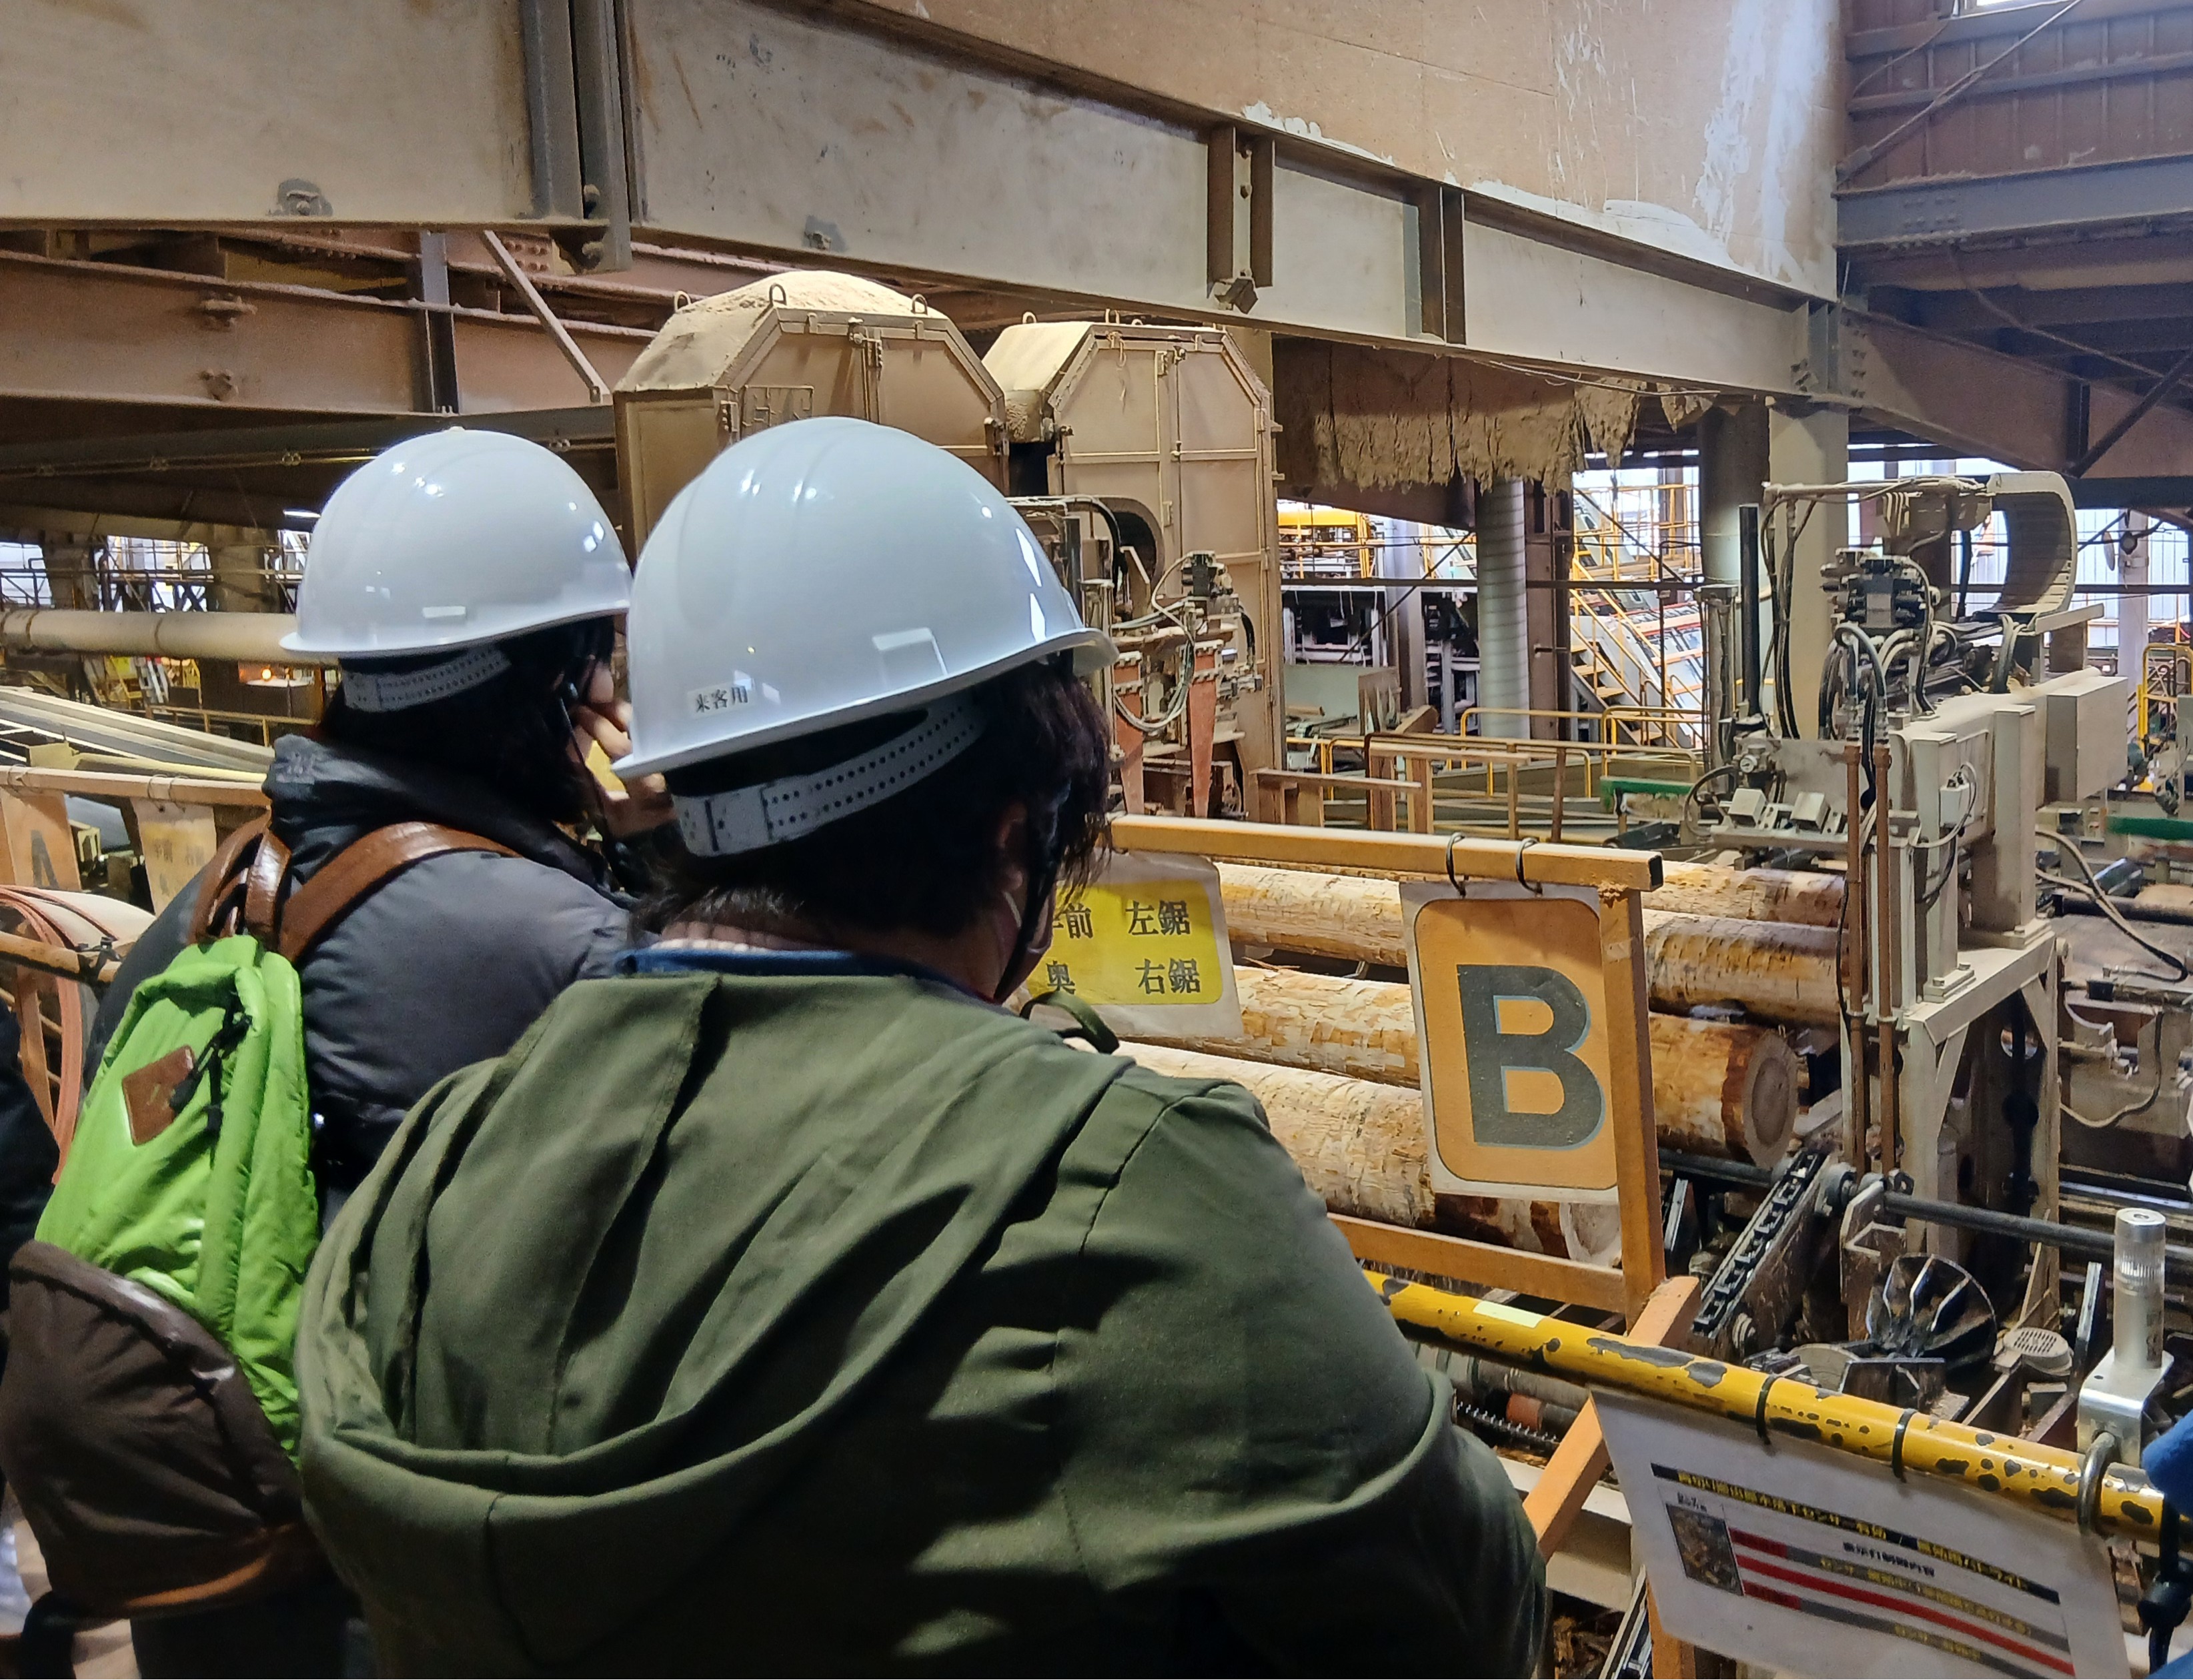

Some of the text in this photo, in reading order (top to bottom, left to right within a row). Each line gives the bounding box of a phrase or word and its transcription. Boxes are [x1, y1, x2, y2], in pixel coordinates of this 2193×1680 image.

[1125, 900, 1191, 936] 左鋸
[1046, 958, 1201, 994] 奥 右鋸
[1457, 964, 1605, 1150] B
